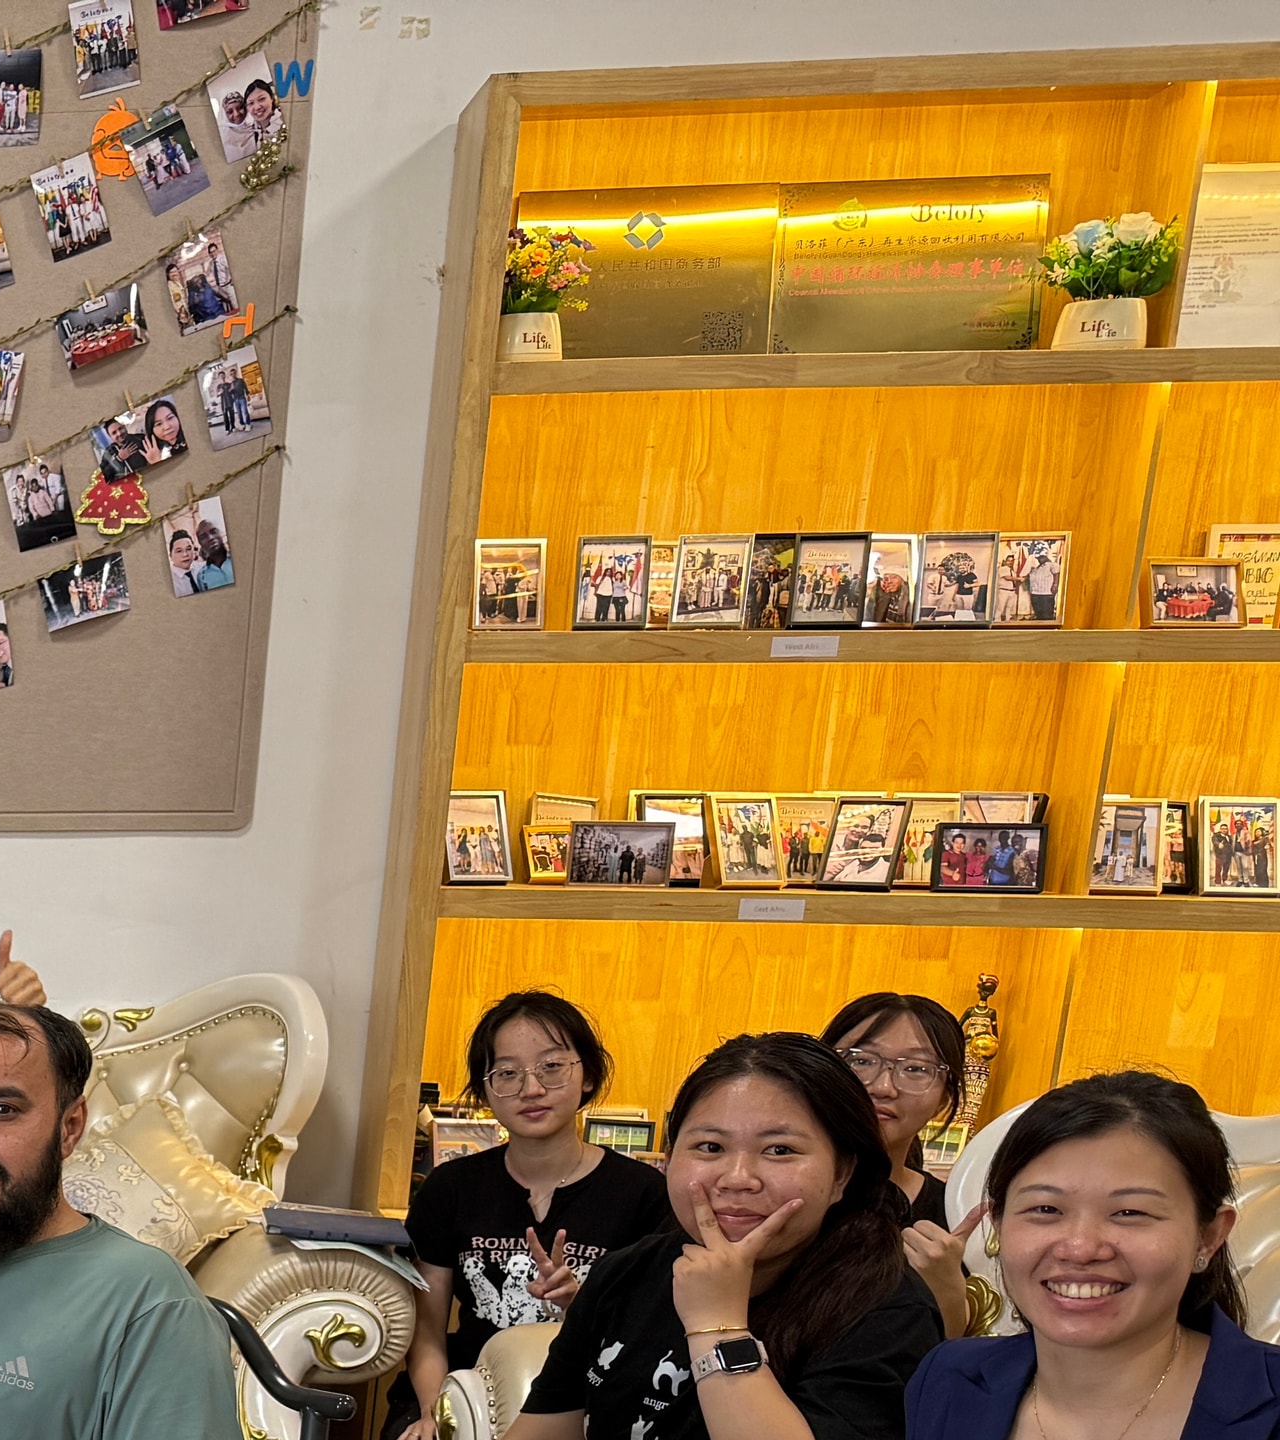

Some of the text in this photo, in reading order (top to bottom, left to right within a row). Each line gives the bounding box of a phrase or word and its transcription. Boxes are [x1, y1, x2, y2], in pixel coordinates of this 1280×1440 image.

[274, 59, 314, 98] W
[1080, 320, 1110, 336] Life
[522, 332, 547, 345] Life
[643, 1397, 670, 1411] angr
